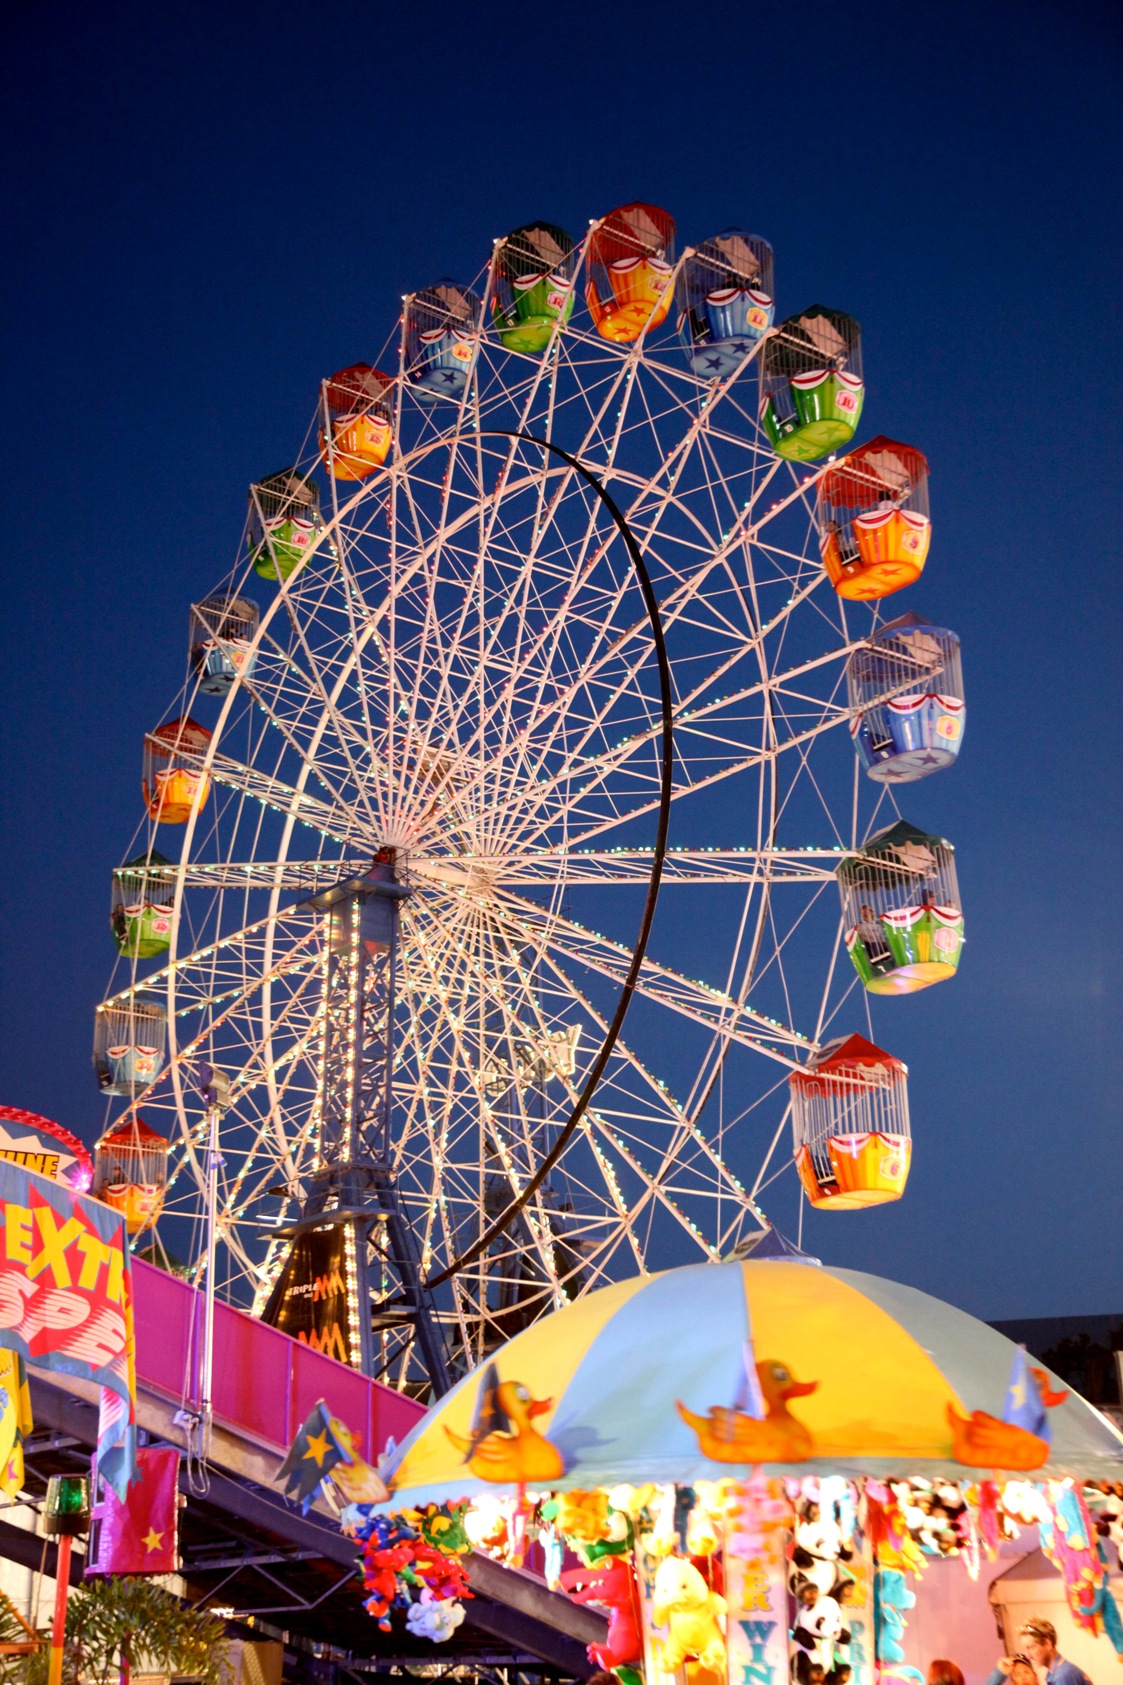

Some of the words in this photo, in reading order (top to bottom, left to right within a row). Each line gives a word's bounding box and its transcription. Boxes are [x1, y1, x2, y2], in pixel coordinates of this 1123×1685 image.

[841, 397, 855, 409] 10
[890, 1161, 900, 1176] 6
[289, 1282, 321, 1297] TRIPLE
[738, 1620, 778, 1685] WIN
